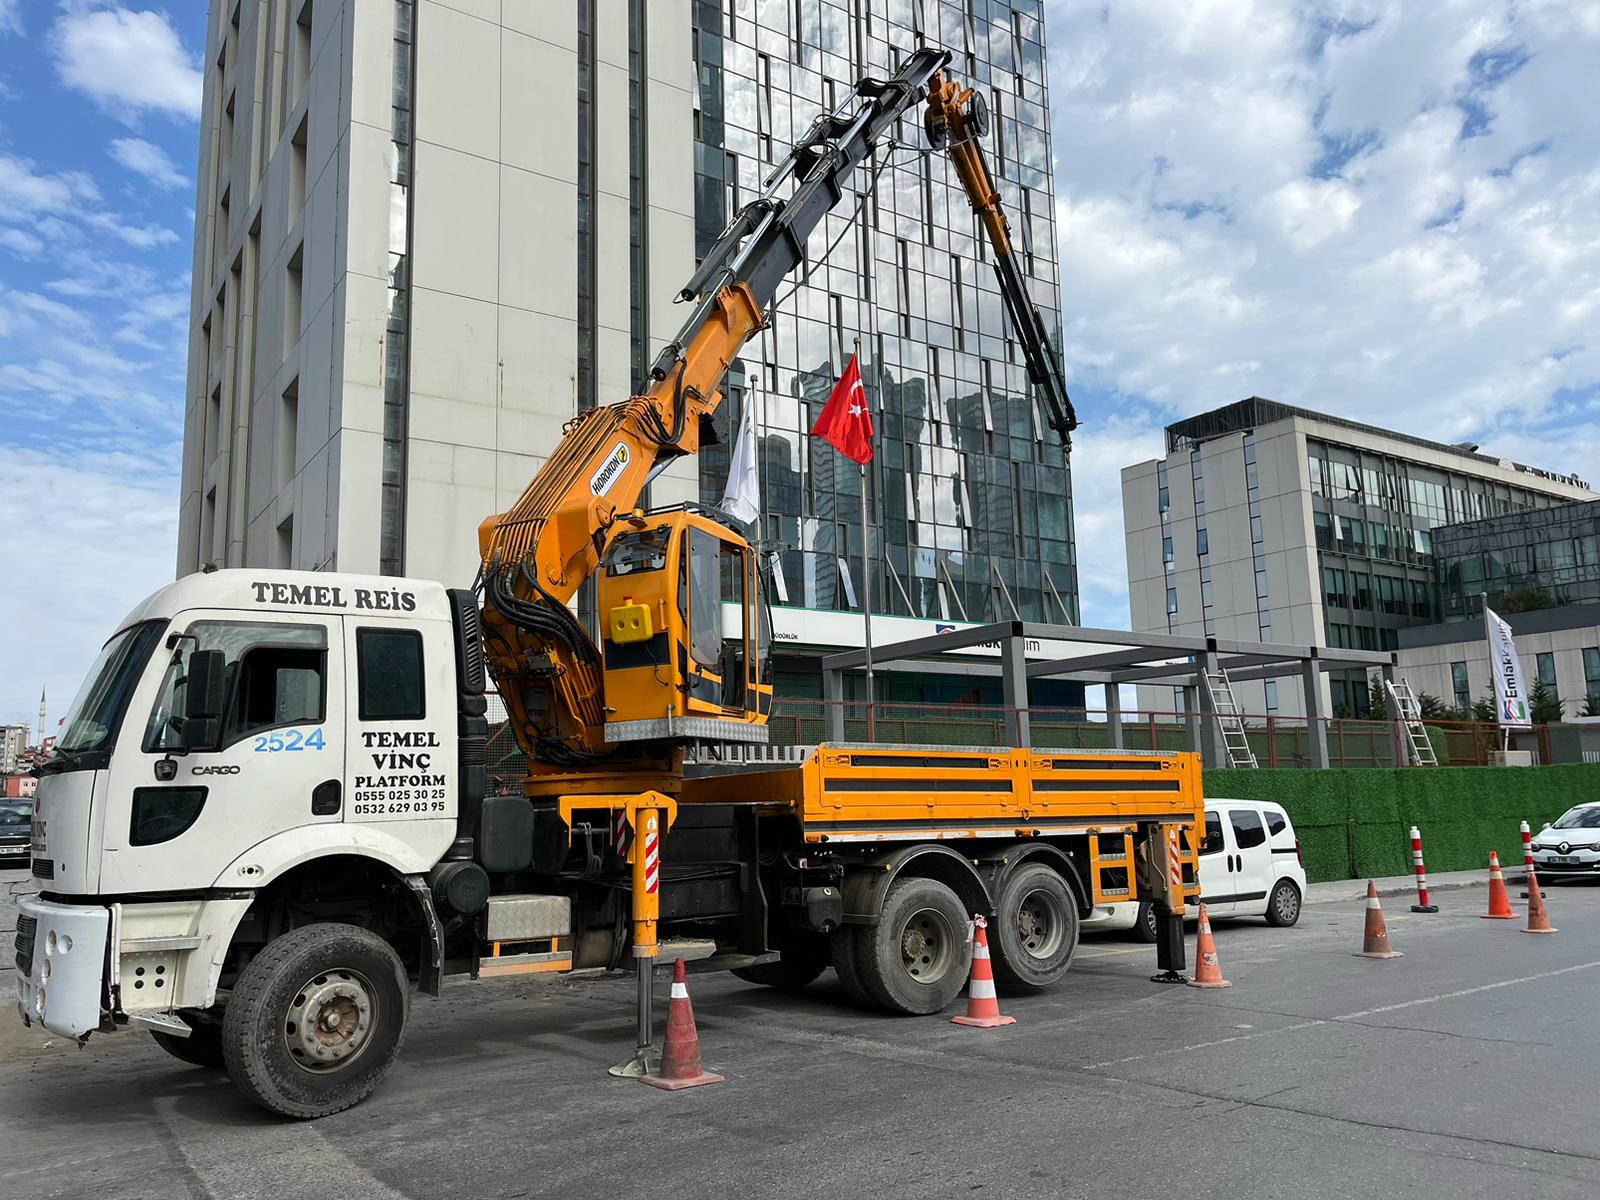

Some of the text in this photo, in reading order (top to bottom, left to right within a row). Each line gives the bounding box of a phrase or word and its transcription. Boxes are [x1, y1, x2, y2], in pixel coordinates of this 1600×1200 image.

[251, 581, 347, 608] TEMEL
[254, 727, 326, 752] 2524
[361, 732, 440, 748] TEMEL
[371, 749, 431, 773] VİNÇ
[191, 765, 241, 776] CARGO
[355, 774, 446, 788] PLATFORM
[355, 789, 445, 801] 0555 025 30 25
[355, 801, 445, 814] 0532 629 03 95
